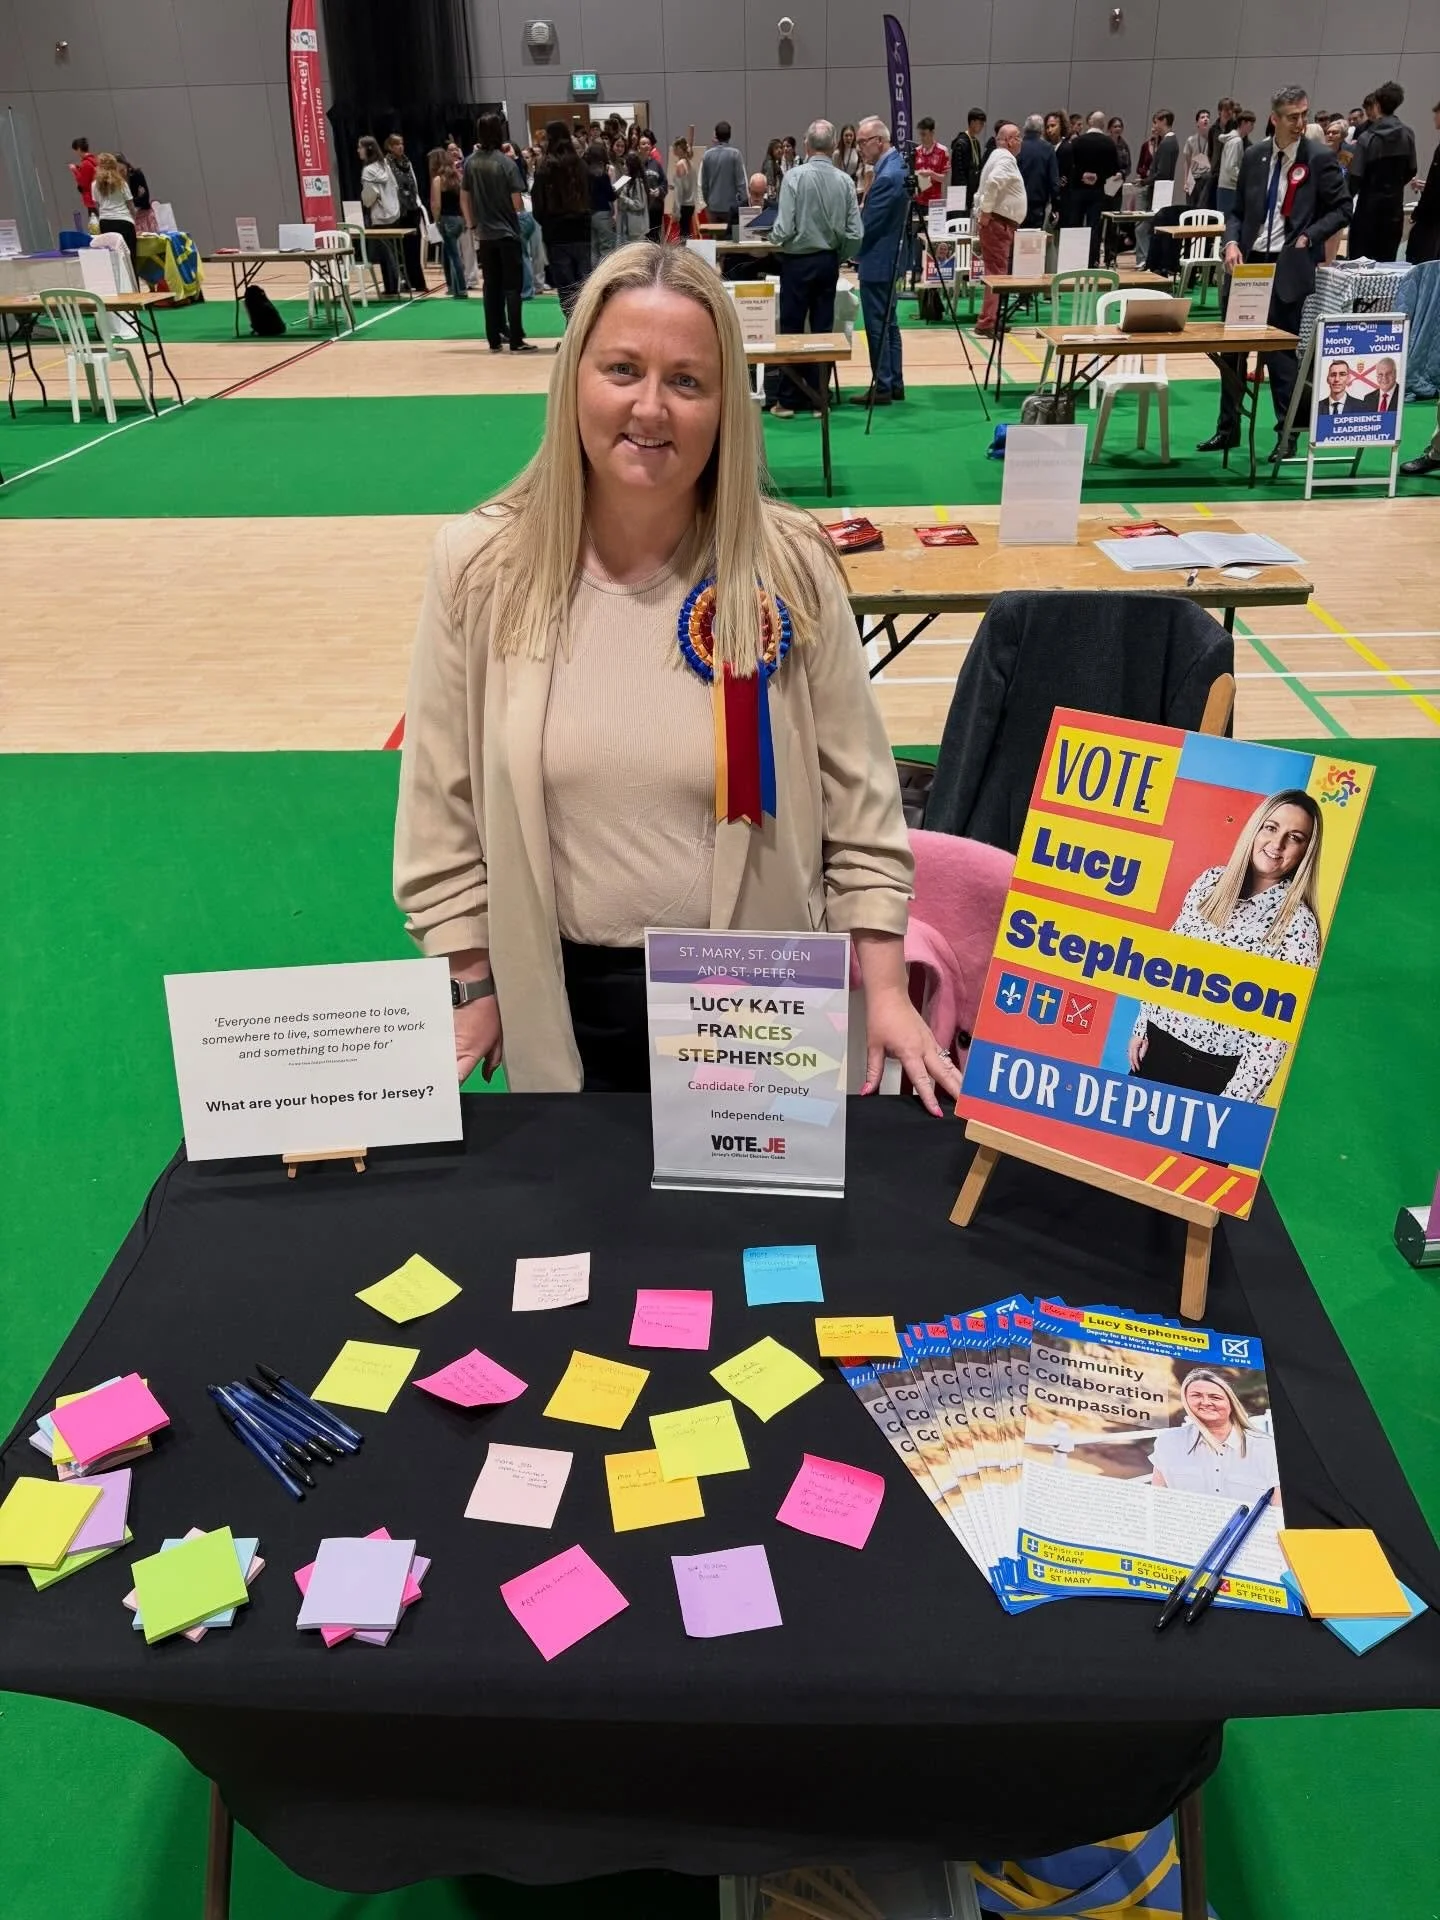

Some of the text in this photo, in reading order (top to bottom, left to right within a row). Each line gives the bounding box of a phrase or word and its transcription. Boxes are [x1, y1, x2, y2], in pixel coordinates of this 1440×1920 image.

[1325, 337, 1352, 346] Monty
[1375, 335, 1395, 343] John
[1324, 346, 1355, 355] TADIER
[1369, 344, 1400, 353] YOUNG
[1333, 415, 1382, 424] EXPERIENCE
[1333, 424, 1382, 434] LEADERSHIP
[1323, 433, 1390, 443] ACCOUNTABILITY
[1056, 739, 1163, 814] VOTE
[1032, 827, 1142, 896] Lucy
[679, 946, 811, 961] ST. MARY, ST. OUEN
[697, 965, 796, 979] AND ST. PETER
[1006, 909, 1297, 1023] Stephenson
[689, 996, 805, 1015] LUCY KATE
[274, 1012, 310, 1024] needs
[312, 1008, 366, 1021] someone
[369, 1007, 381, 1017] to
[383, 1005, 410, 1017] love,
[202, 1020, 426, 1045] somewhere to live, somewhere to work
[697, 1023, 793, 1041] FRANCES
[239, 1048, 261, 1059] and
[264, 1044, 325, 1058] something
[327, 1043, 339, 1053] to
[341, 1040, 371, 1054] hope
[678, 1048, 817, 1067] STEPHENSON
[688, 1080, 810, 1097] Candidate for Deputy
[206, 1085, 435, 1113] What are your hopes for Jersey?
[988, 1051, 1232, 1149] FOR DEPUTY
[711, 1109, 784, 1122] Independent
[711, 1134, 786, 1154] VOTE.JE
[1088, 1316, 1121, 1330] Lucy
[1124, 1323, 1206, 1345] Stephenson
[1086, 1328, 1109, 1338] Deputy
[1184, 1346, 1202, 1354] Peter
[1037, 1348, 1144, 1382] Community
[1035, 1367, 1164, 1403] Collaboration
[1034, 1387, 1151, 1421] Compassion
[1043, 1544, 1071, 1555] PARISH
[1043, 1551, 1084, 1565] ST MARY
[1137, 1561, 1169, 1572] PARISH
[1137, 1566, 1151, 1576] ST
[1050, 1575, 1092, 1585] ST MARY
[1235, 1581, 1281, 1595] PARISH OF
[1236, 1588, 1282, 1604] ST PETER
